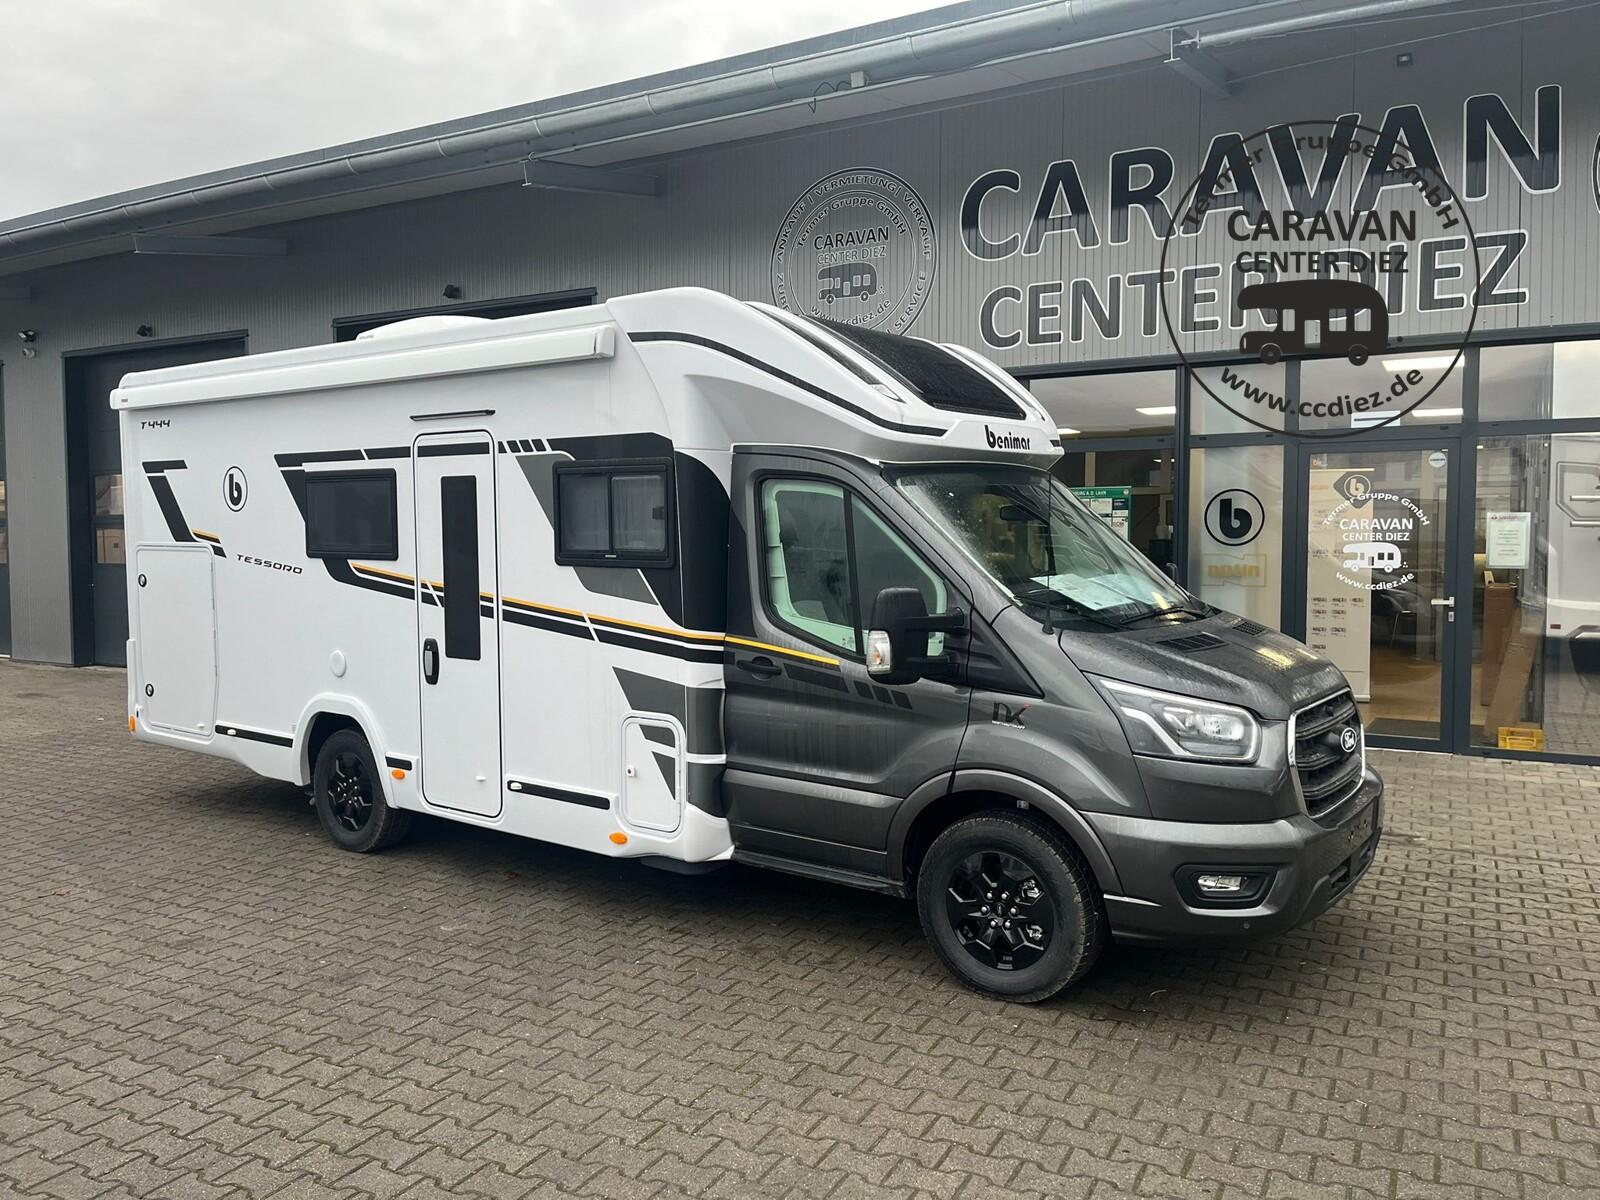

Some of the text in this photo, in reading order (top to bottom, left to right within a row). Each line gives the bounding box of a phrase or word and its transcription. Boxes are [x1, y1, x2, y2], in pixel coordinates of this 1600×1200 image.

[960, 84, 1561, 262] CARAVAN
[777, 175, 932, 264] ANKAUF VERMIETUNG VERKAUF
[797, 197, 907, 248] Termer Gruppe GmbH
[814, 226, 889, 251] CARAVAN
[817, 246, 887, 265] CENTER DIEZ
[811, 299, 891, 326] wwcdiez.de
[894, 272, 927, 331] SERVICE
[979, 258, 1281, 349] CENTER
[984, 424, 1031, 450] benimar
[1322, 497, 1355, 525] Termer
[1357, 492, 1399, 502] Gruppe
[1400, 498, 1431, 526] GmbH
[1339, 518, 1414, 530] CARAVAN
[1342, 532, 1410, 541] CENTER DIEZ
[236, 554, 304, 574] TESSORO
[1335, 572, 1415, 591] www.ccdiez.de
